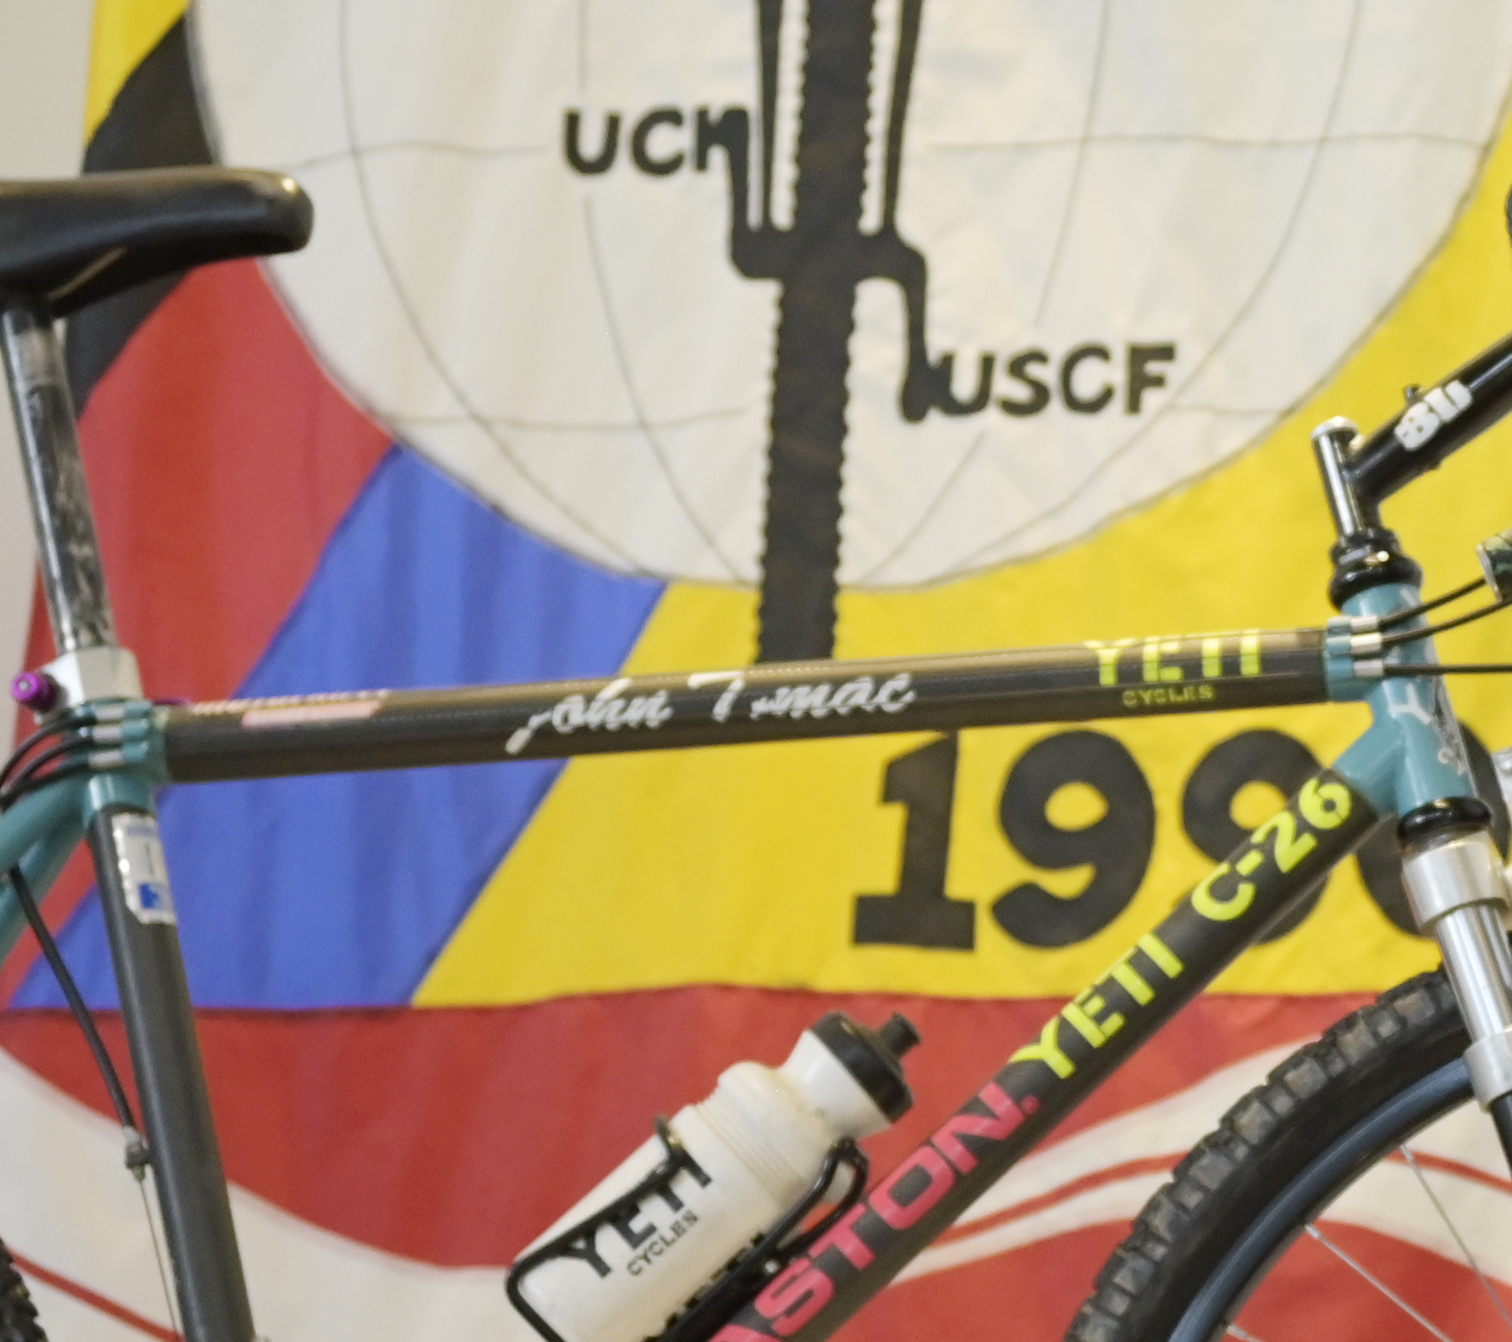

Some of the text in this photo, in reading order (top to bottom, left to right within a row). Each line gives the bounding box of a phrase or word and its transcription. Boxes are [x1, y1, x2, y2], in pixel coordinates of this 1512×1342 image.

[934, 343, 1176, 417] USCF
[1085, 629, 1261, 686] YETI
[1123, 685, 1214, 707] CYCLES
[1007, 777, 1352, 1079] YETI C-26
[565, 1147, 713, 1280] YETI
[626, 1210, 699, 1276] CYCLES
